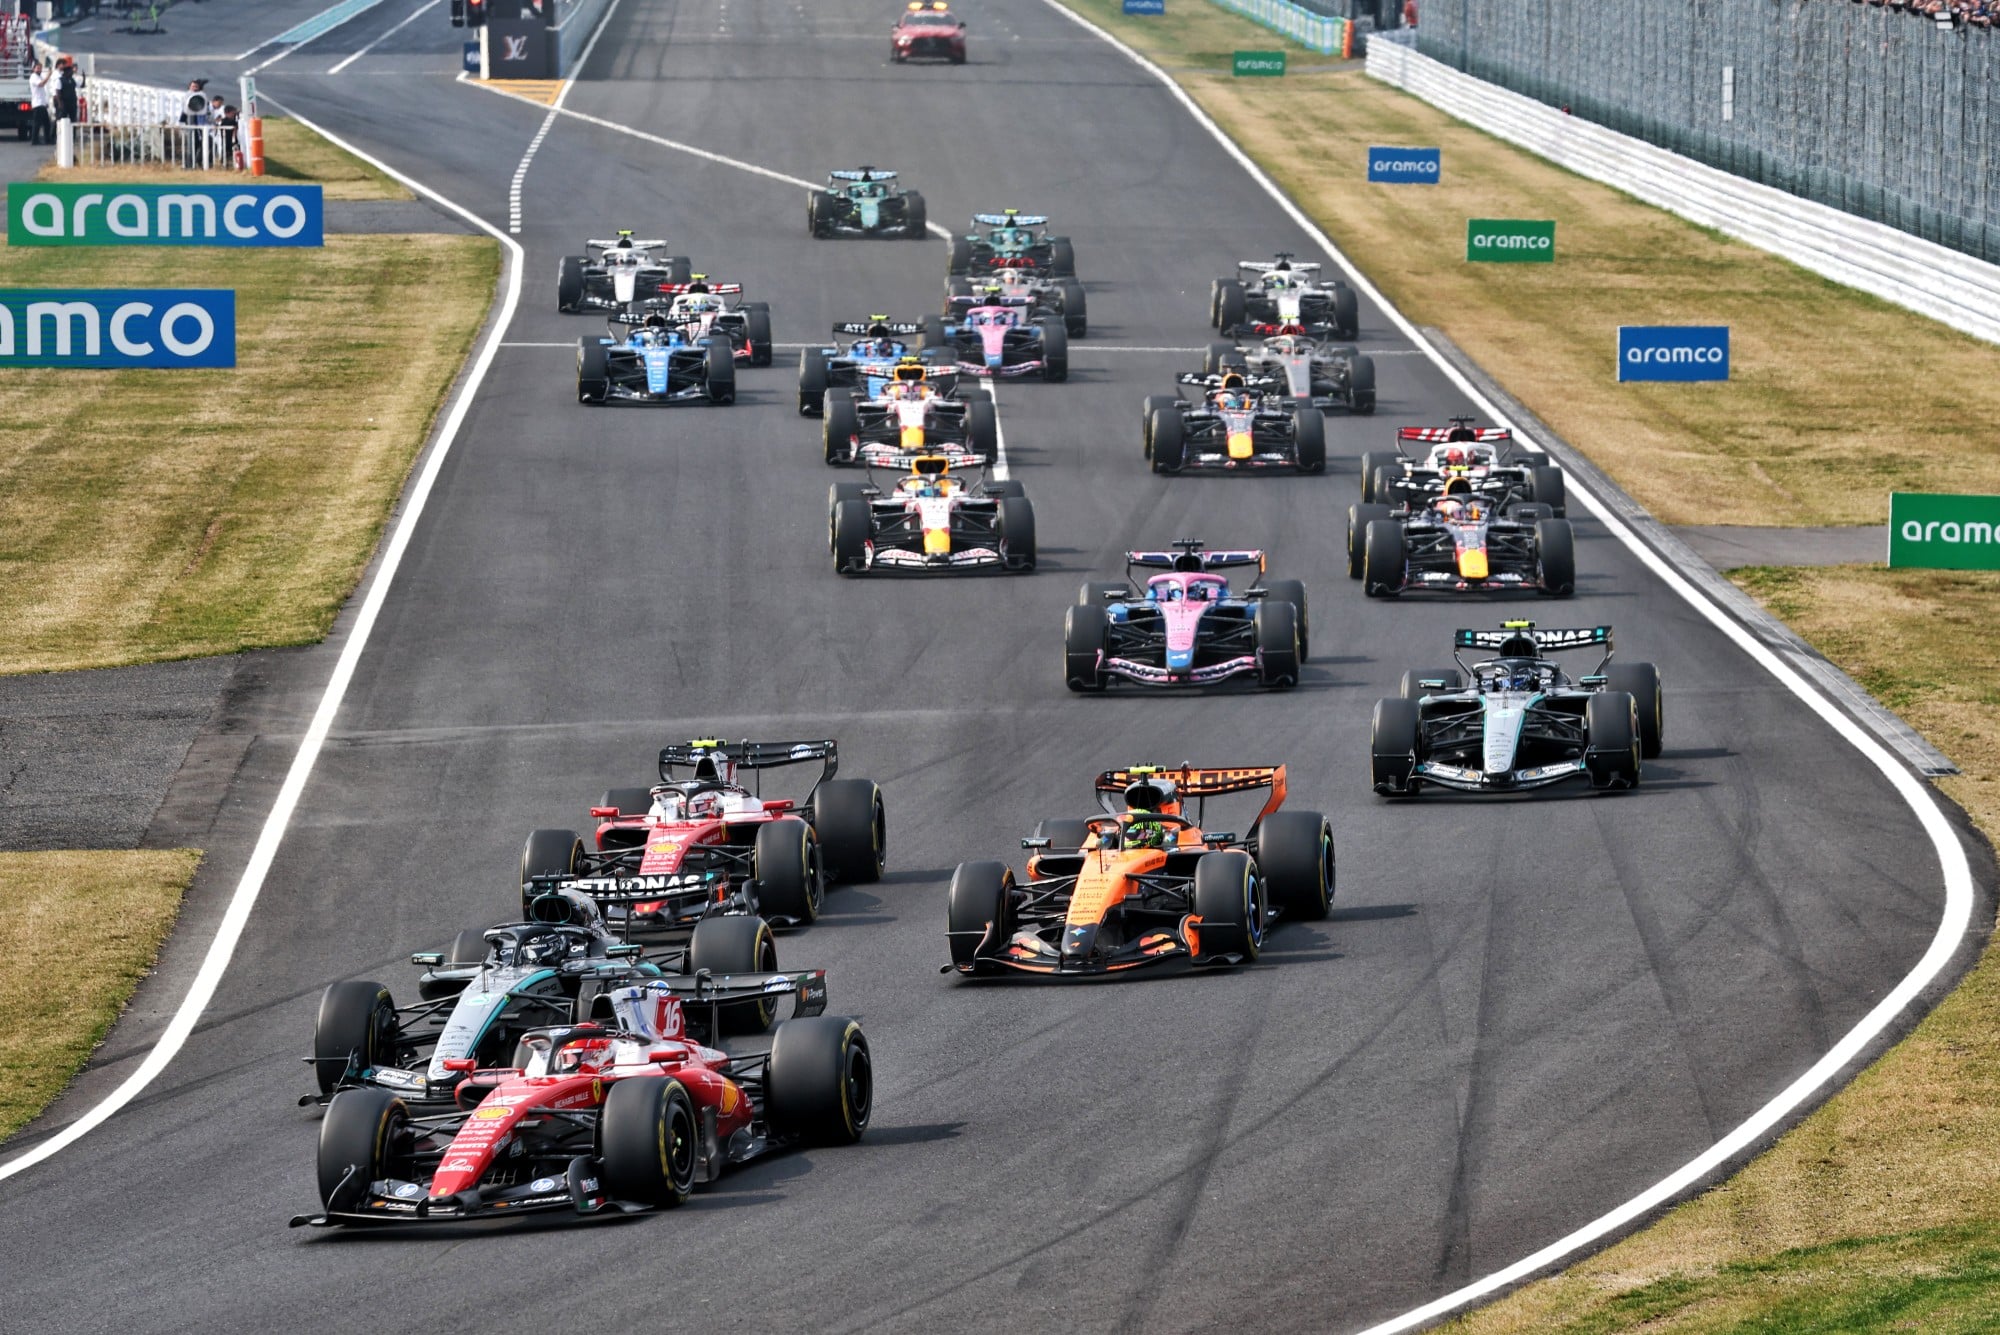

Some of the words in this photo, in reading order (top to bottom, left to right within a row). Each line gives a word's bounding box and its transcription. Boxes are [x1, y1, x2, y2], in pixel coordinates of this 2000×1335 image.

[1374, 158, 1437, 174] aramco
[22, 193, 306, 238] aramco
[1473, 232, 1550, 250] aramco
[0, 301, 214, 357] mco
[1626, 345, 1722, 364] aramco
[1901, 520, 2000, 544] aram
[561, 874, 701, 897] PETRONAS
[662, 1000, 681, 1037] 16
[554, 1095, 575, 1109] RICHARD
[575, 1091, 589, 1102] MILLE
[463, 1119, 504, 1129] IBM
[398, 1184, 417, 1196] hp
[534, 1179, 553, 1192] hp
